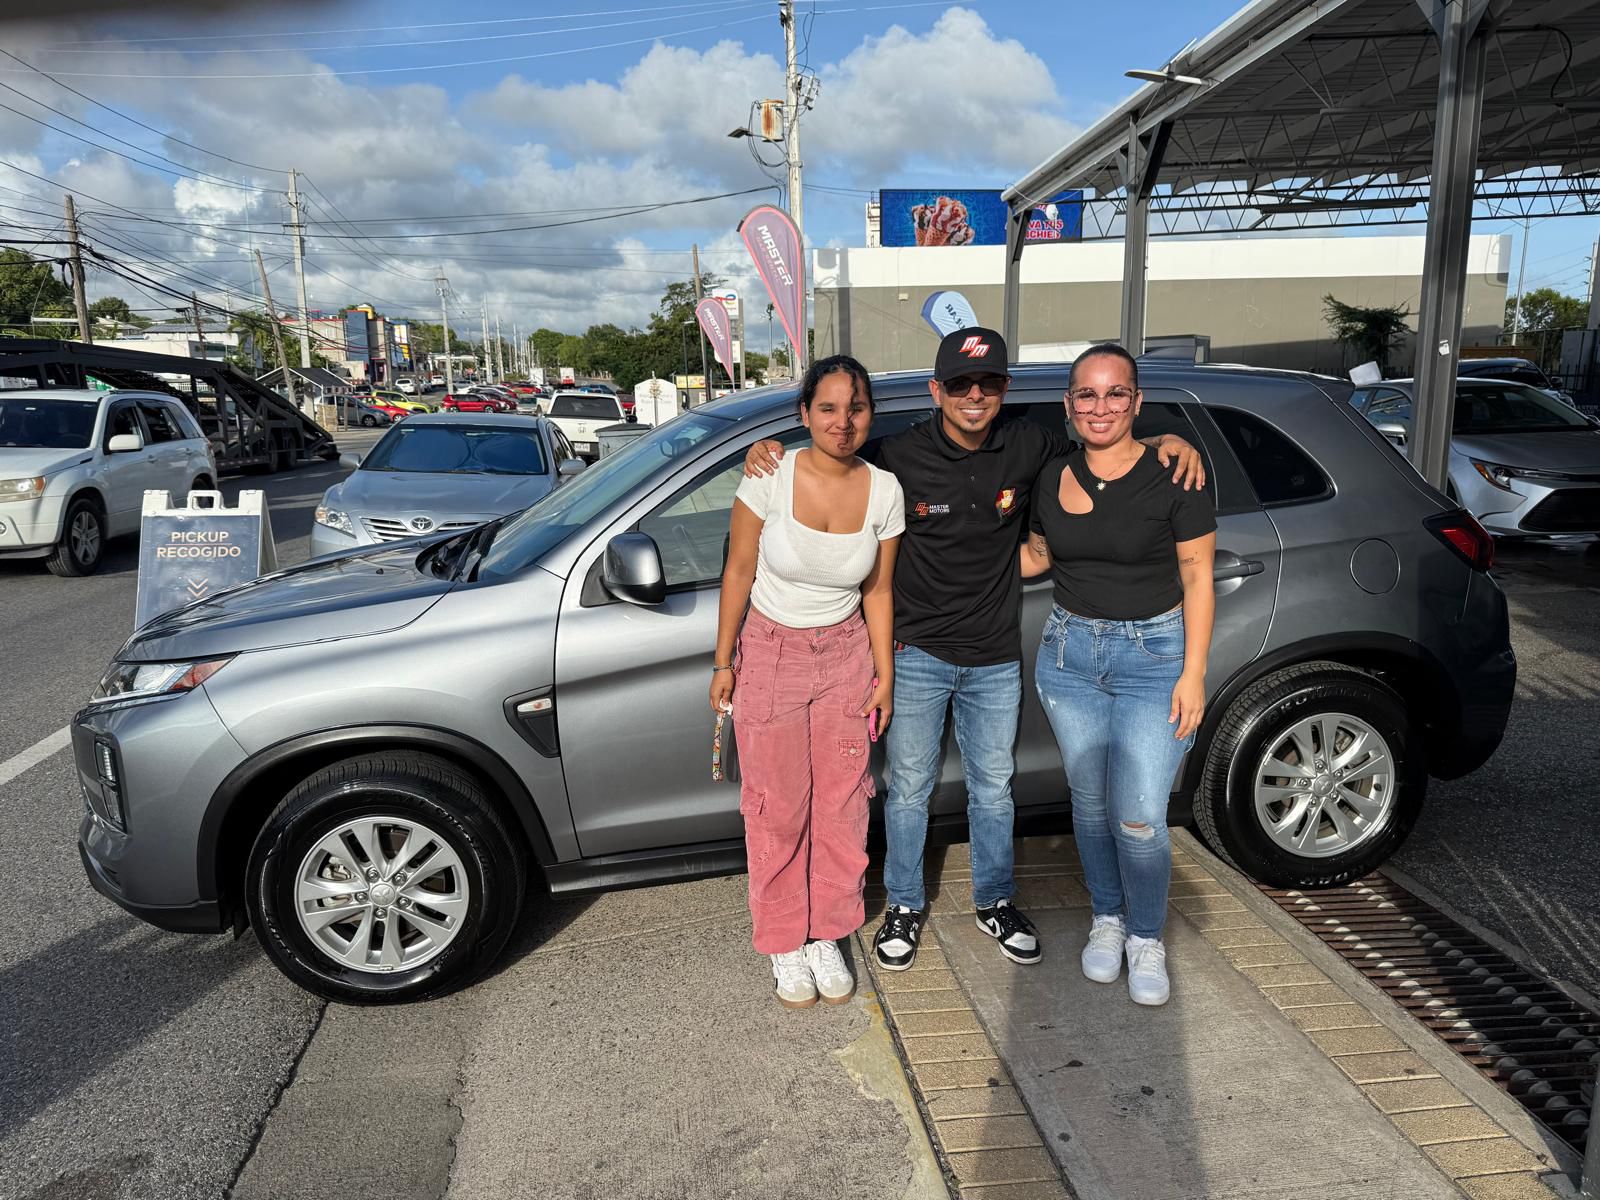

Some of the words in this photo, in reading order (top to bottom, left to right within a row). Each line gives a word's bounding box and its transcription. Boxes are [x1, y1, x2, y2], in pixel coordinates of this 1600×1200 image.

[757, 225, 793, 286] MASTER
[704, 308, 725, 341] MASTER
[171, 532, 229, 542] PICKUP
[157, 546, 241, 558] RECOGIDO
